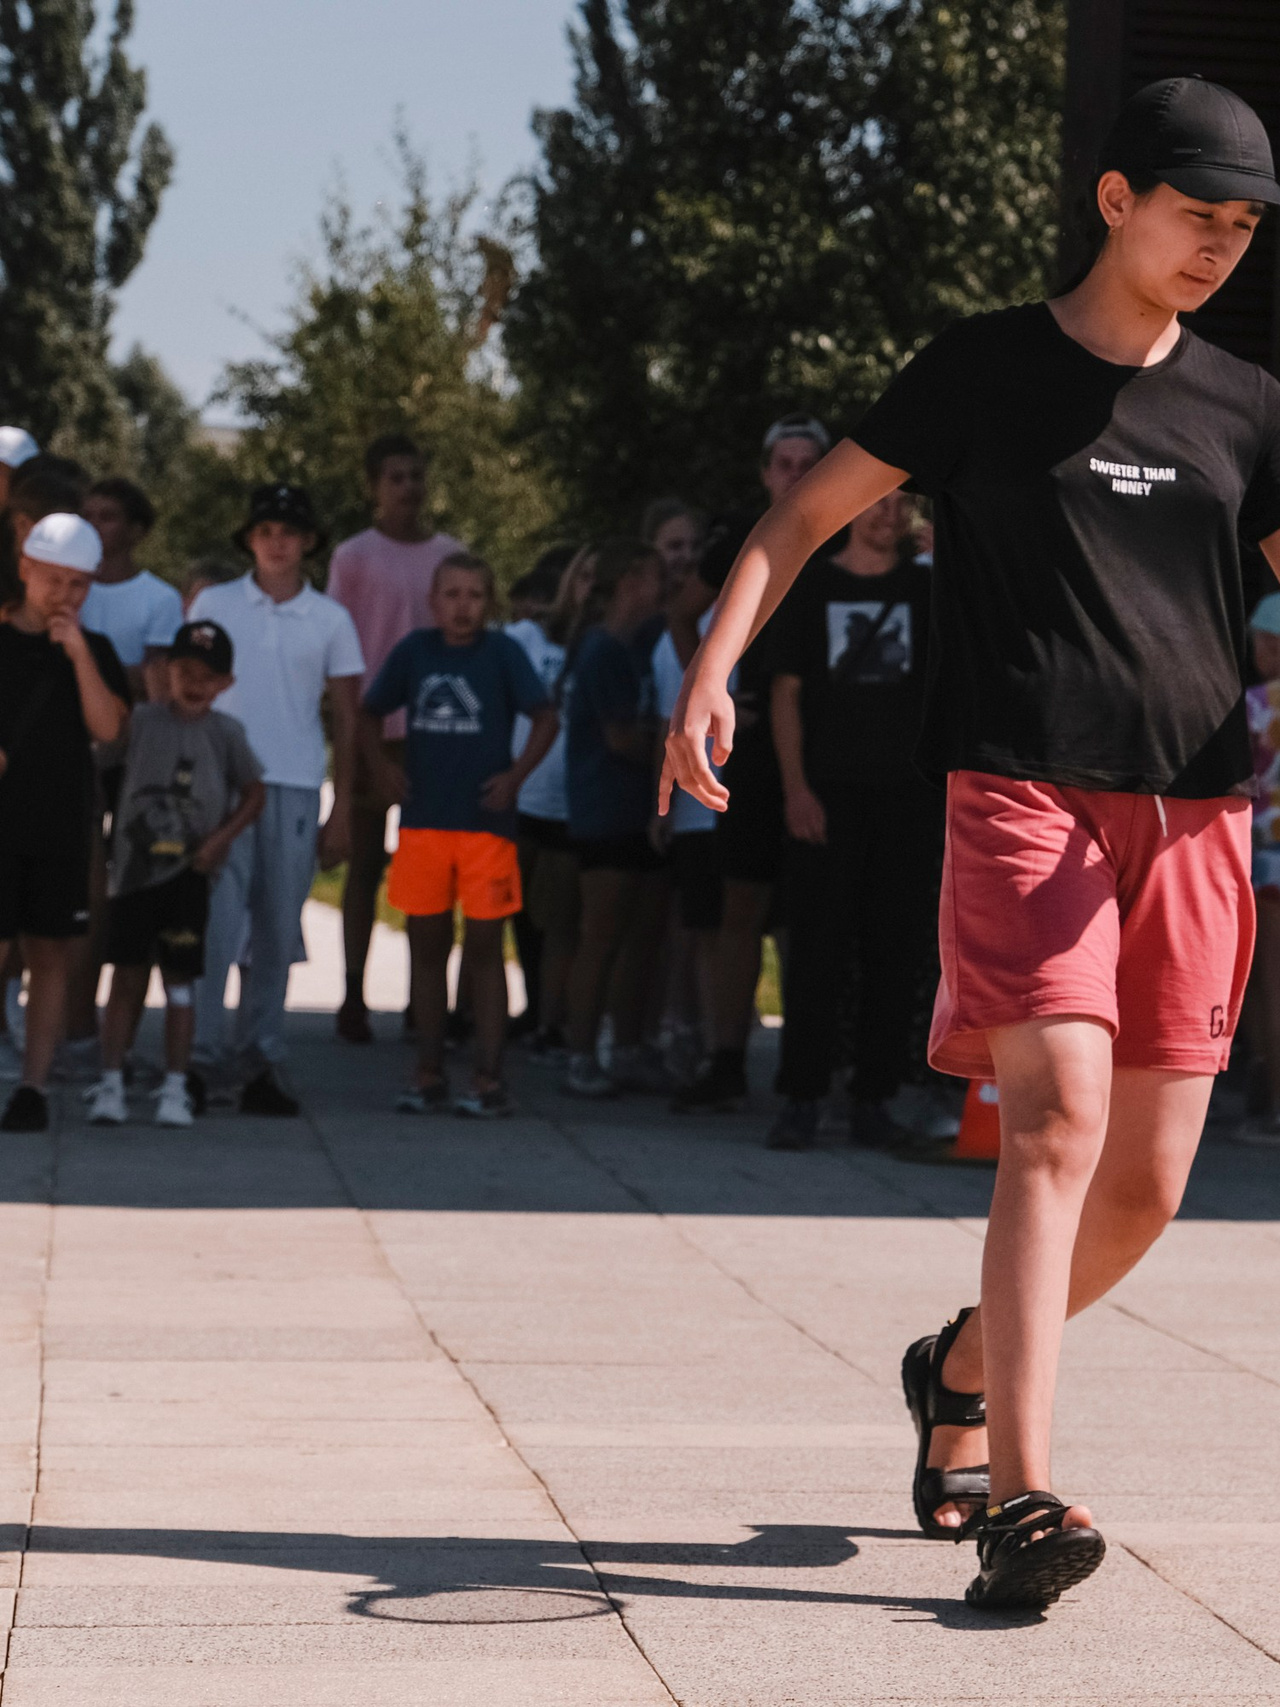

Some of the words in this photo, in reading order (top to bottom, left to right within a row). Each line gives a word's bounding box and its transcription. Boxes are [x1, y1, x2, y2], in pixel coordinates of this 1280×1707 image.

[1090, 458, 1140, 479] SWEETER
[1143, 467, 1176, 481] THAN
[1112, 479, 1152, 496] HONEY
